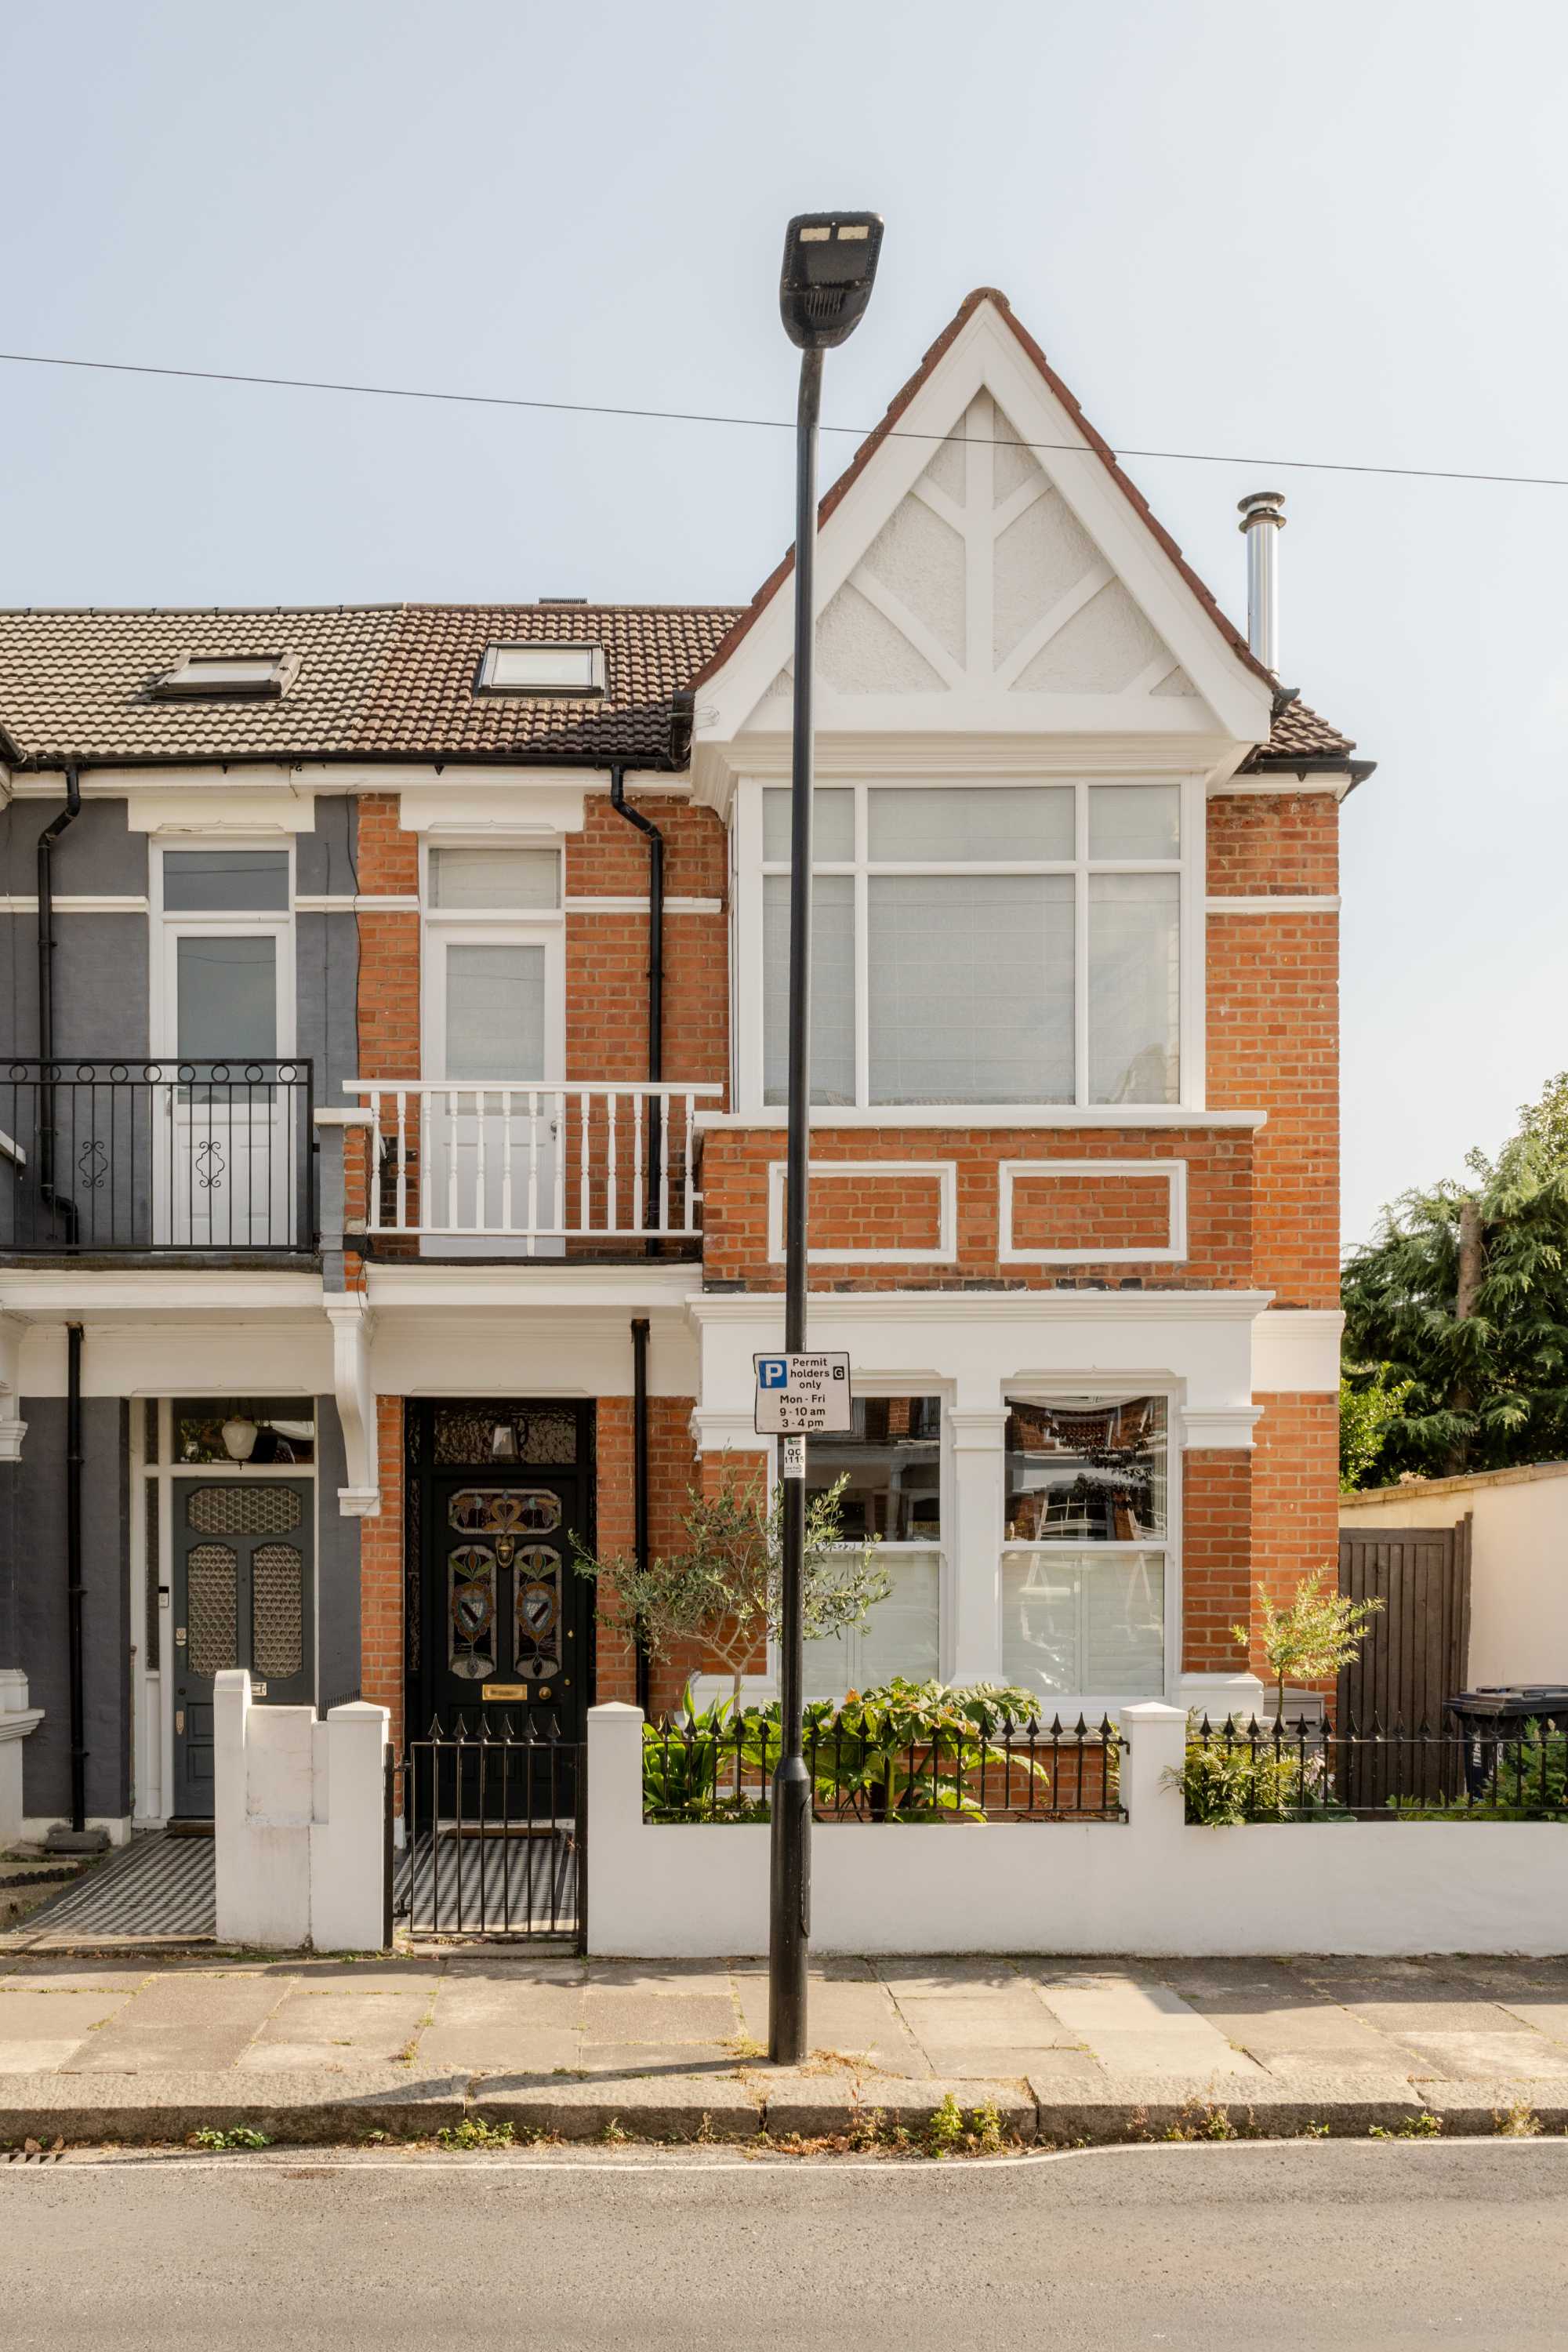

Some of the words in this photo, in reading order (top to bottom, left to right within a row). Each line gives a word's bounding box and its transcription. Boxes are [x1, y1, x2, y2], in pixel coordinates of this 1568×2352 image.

[793, 1358, 827, 1367] Permit
[765, 1363, 783, 1386] P
[790, 1369, 829, 1377] holders
[834, 1367, 844, 1378] G
[799, 1380, 822, 1390] only
[780, 1395, 803, 1403] Mon
[811, 1394, 826, 1403] Fri
[779, 1407, 786, 1416] 9
[795, 1406, 808, 1416] 10
[782, 1418, 789, 1428] 3
[797, 1418, 805, 1427] 4
[808, 1420, 823, 1428] pm
[787, 1448, 801, 1457] QC
[785, 1455, 804, 1464] 1115
